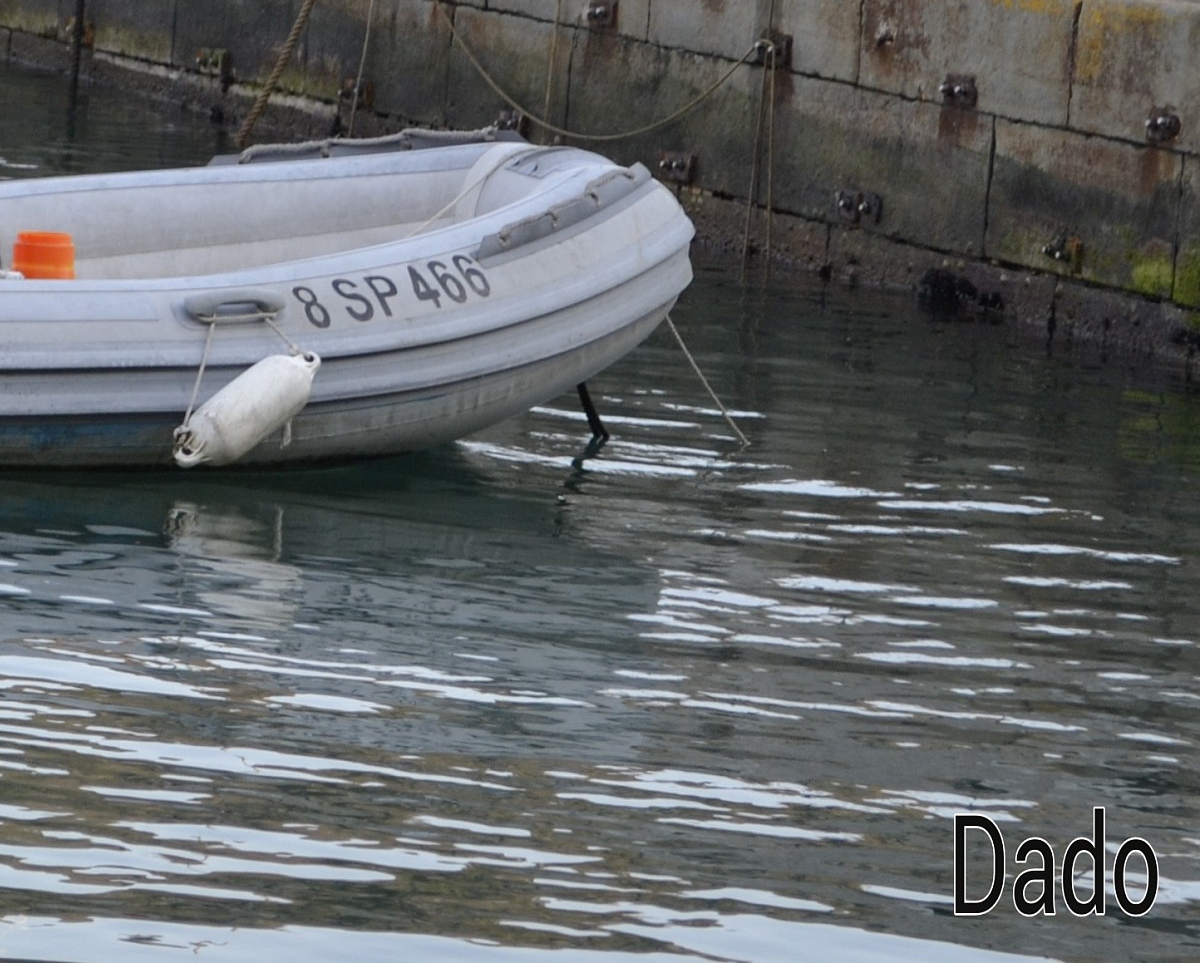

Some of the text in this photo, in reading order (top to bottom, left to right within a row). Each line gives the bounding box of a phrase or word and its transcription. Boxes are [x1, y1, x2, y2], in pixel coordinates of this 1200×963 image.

[292, 254, 491, 329] 8 SP 466
